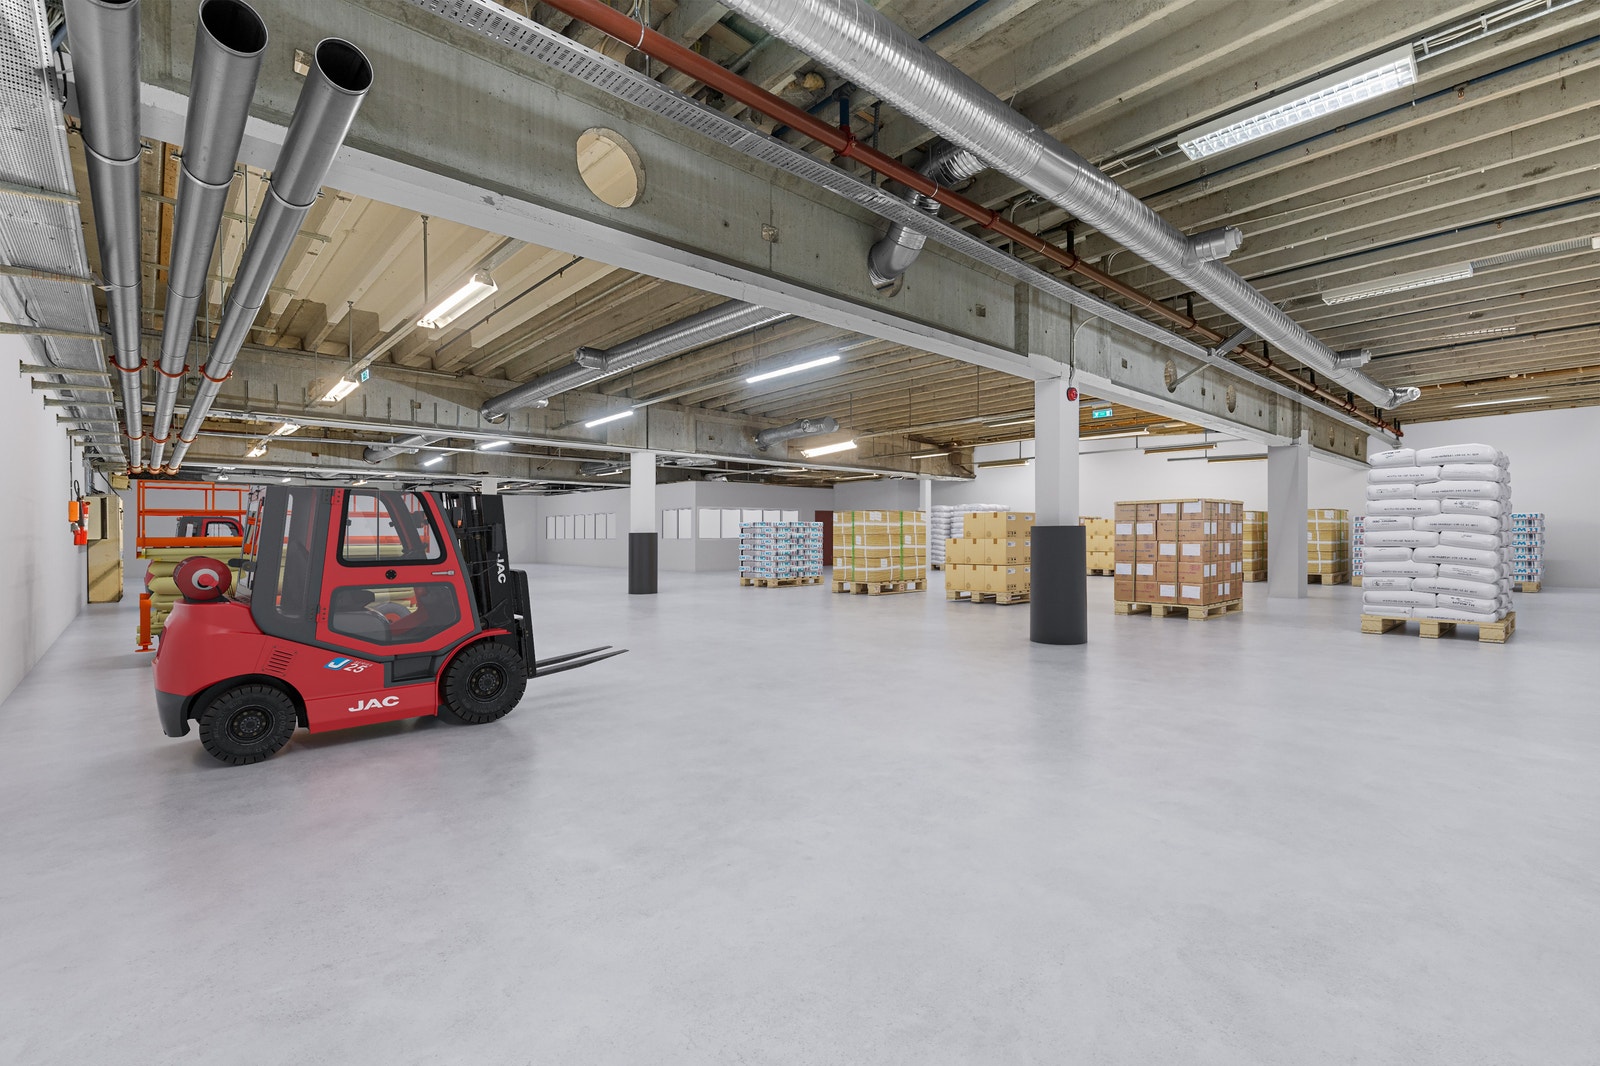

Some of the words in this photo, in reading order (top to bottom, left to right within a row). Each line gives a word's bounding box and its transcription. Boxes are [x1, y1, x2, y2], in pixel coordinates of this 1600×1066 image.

[497, 553, 507, 584] JAC
[343, 663, 368, 673] 25
[348, 695, 400, 712] JAC
